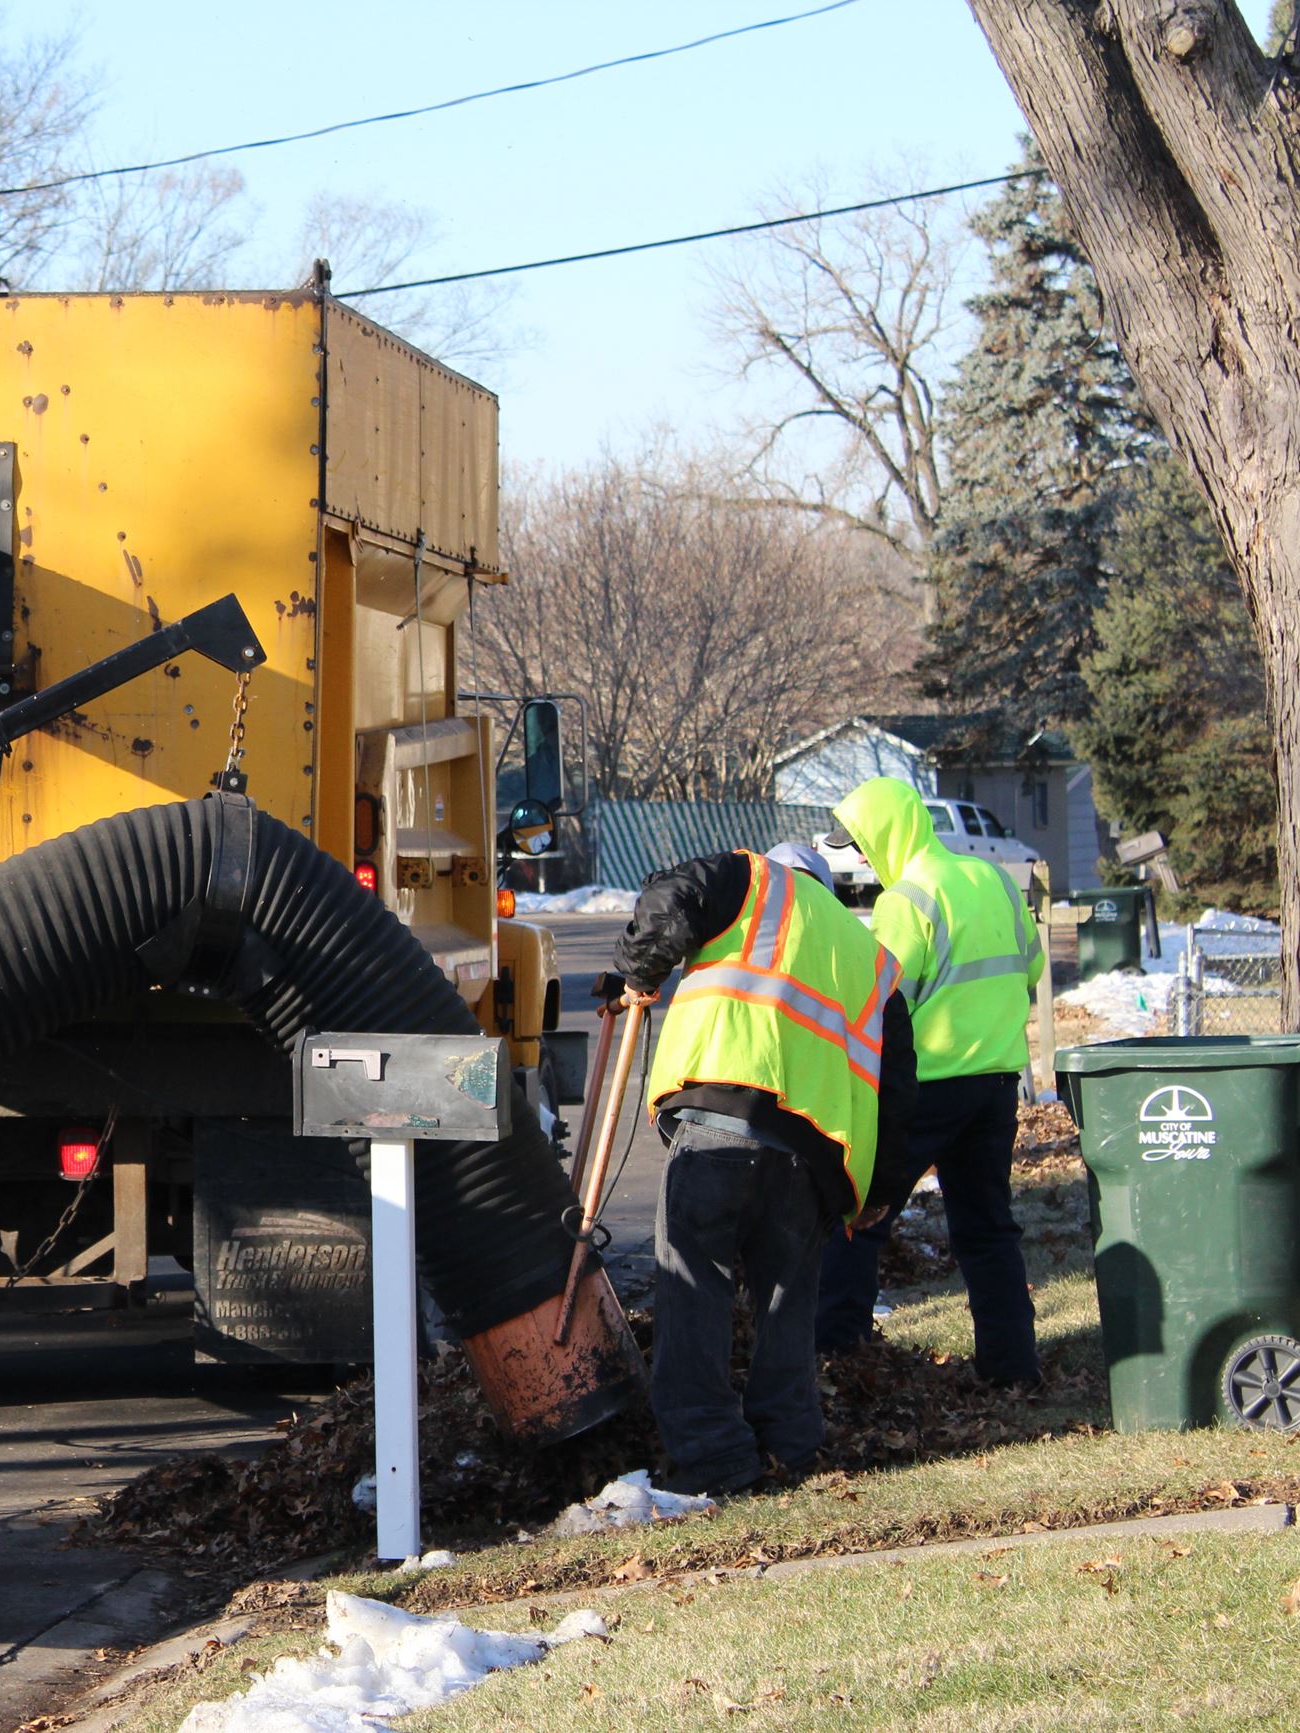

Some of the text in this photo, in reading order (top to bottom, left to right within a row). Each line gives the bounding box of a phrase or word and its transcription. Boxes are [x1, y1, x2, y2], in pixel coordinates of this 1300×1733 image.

[1160, 1122, 1191, 1131] CITY OF
[1139, 1131, 1216, 1144] MUSCATINE
[1142, 1140, 1210, 1161] Iowa
[216, 1240, 367, 1272] Henderson
[216, 1270, 267, 1290] Truck
